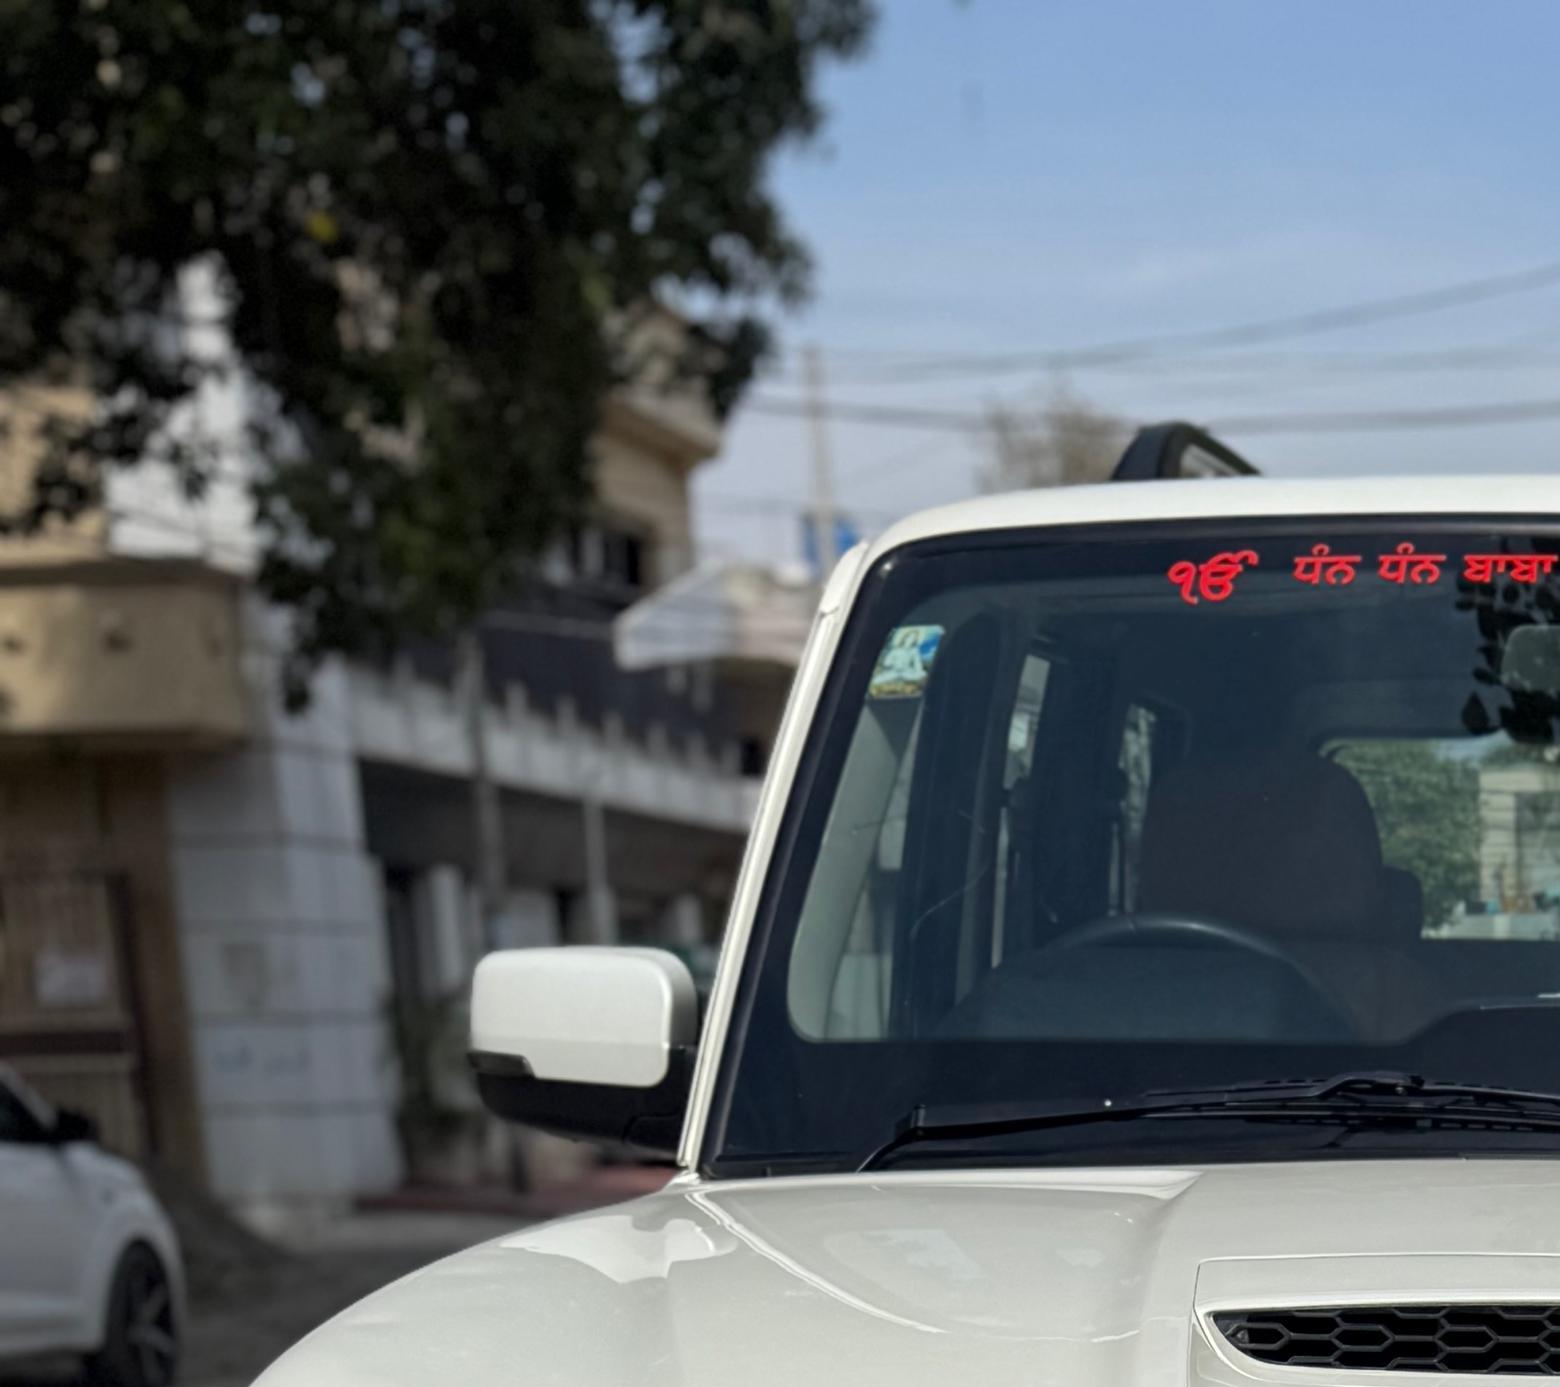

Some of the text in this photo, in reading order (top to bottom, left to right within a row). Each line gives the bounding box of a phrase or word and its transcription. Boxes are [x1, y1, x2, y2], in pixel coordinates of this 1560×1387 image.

[1293, 543, 1362, 585] ਧੰਨ
[1378, 542, 1447, 584] ਧੰਨ
[1463, 554, 1559, 583] ਬਾਬਾ
